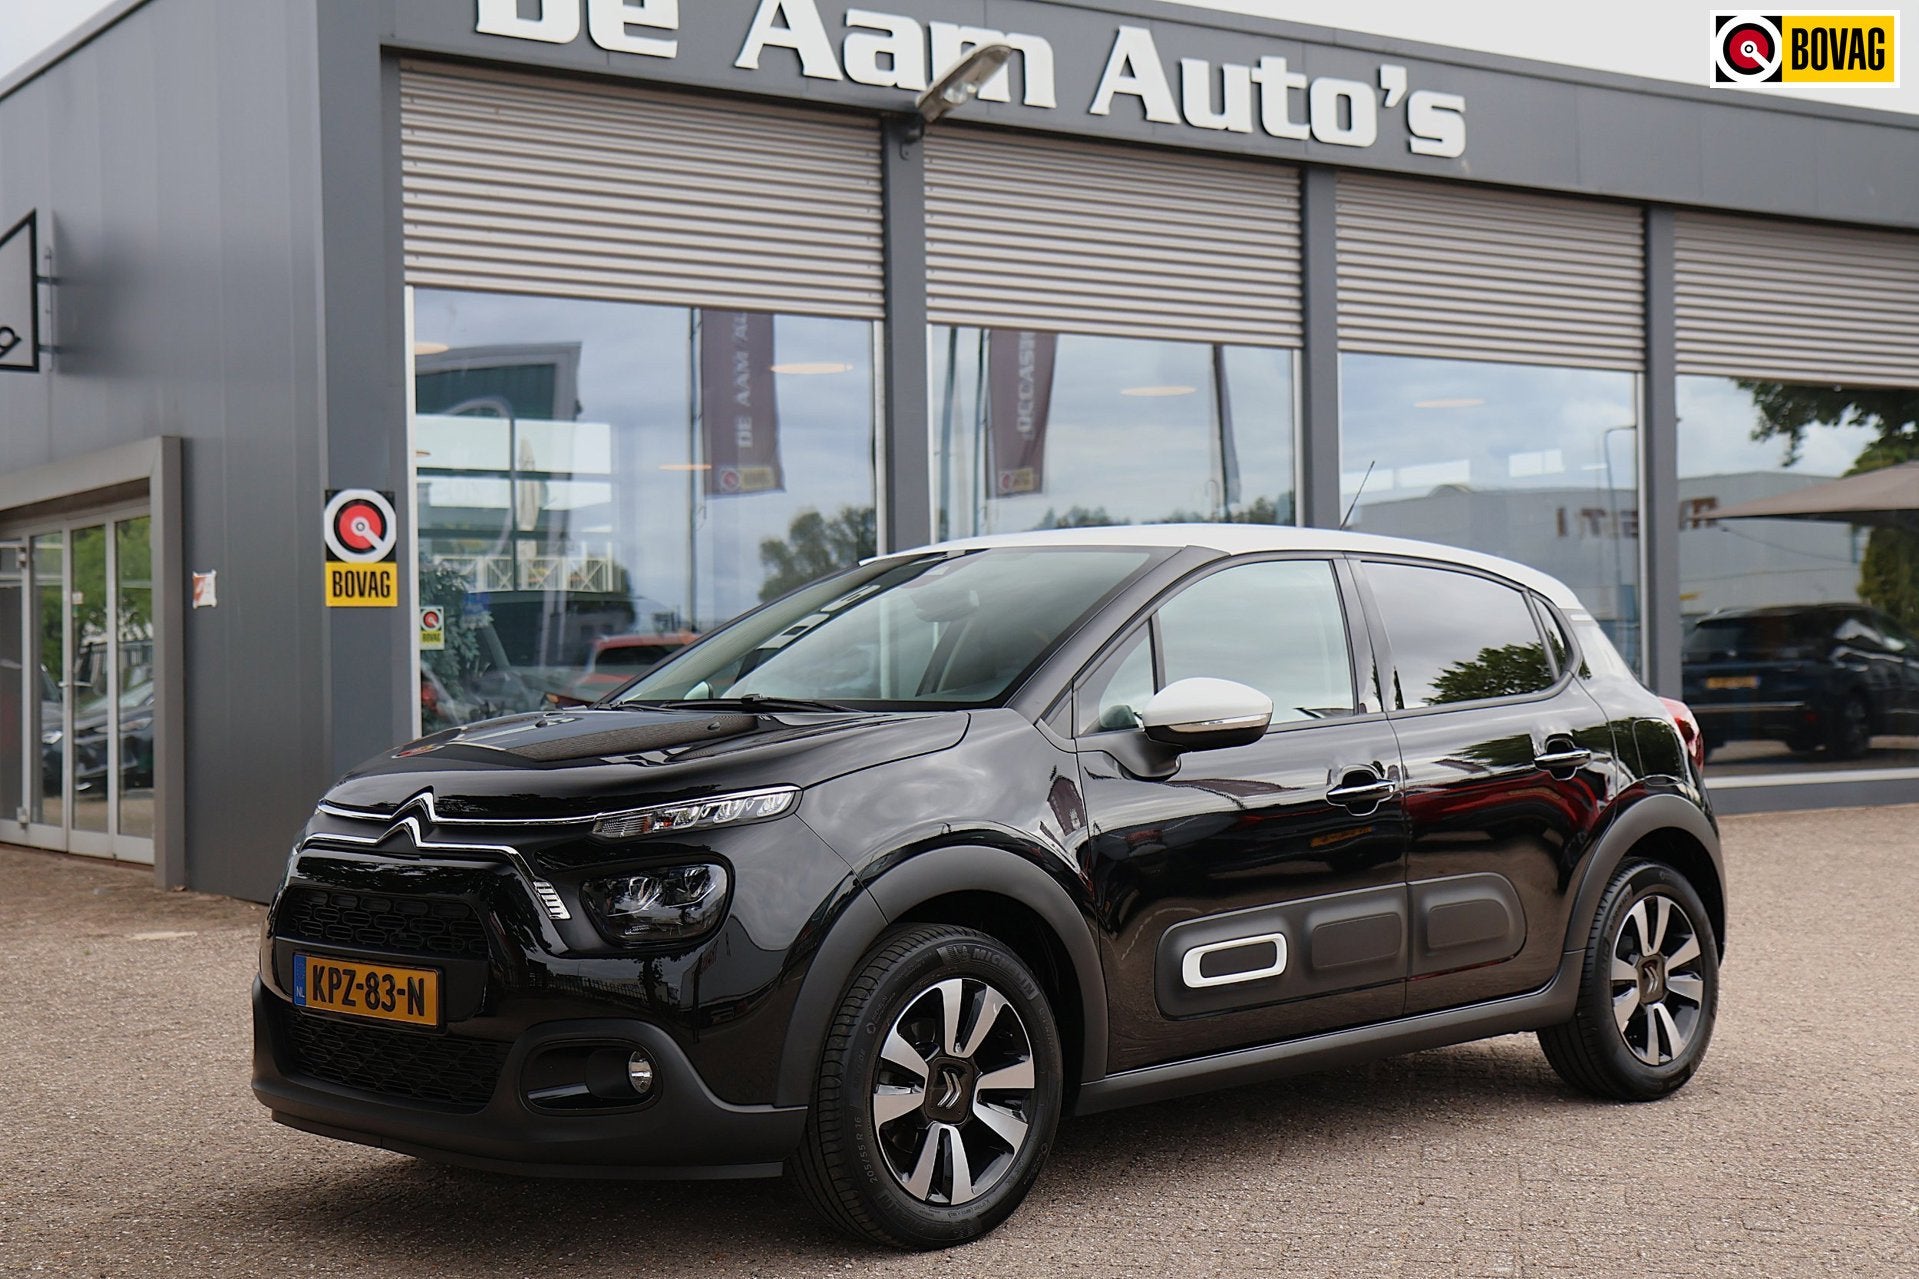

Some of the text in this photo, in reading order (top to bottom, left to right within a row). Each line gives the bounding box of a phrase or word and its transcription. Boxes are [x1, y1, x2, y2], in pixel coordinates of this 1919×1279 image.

[734, 0, 1058, 109] Aam
[1088, 25, 1467, 159] Auto's
[332, 570, 391, 598] BOVAG
[296, 985, 305, 999] NL
[312, 964, 425, 1017] KPZ-83-N
[858, 1144, 879, 1184] 205/55
